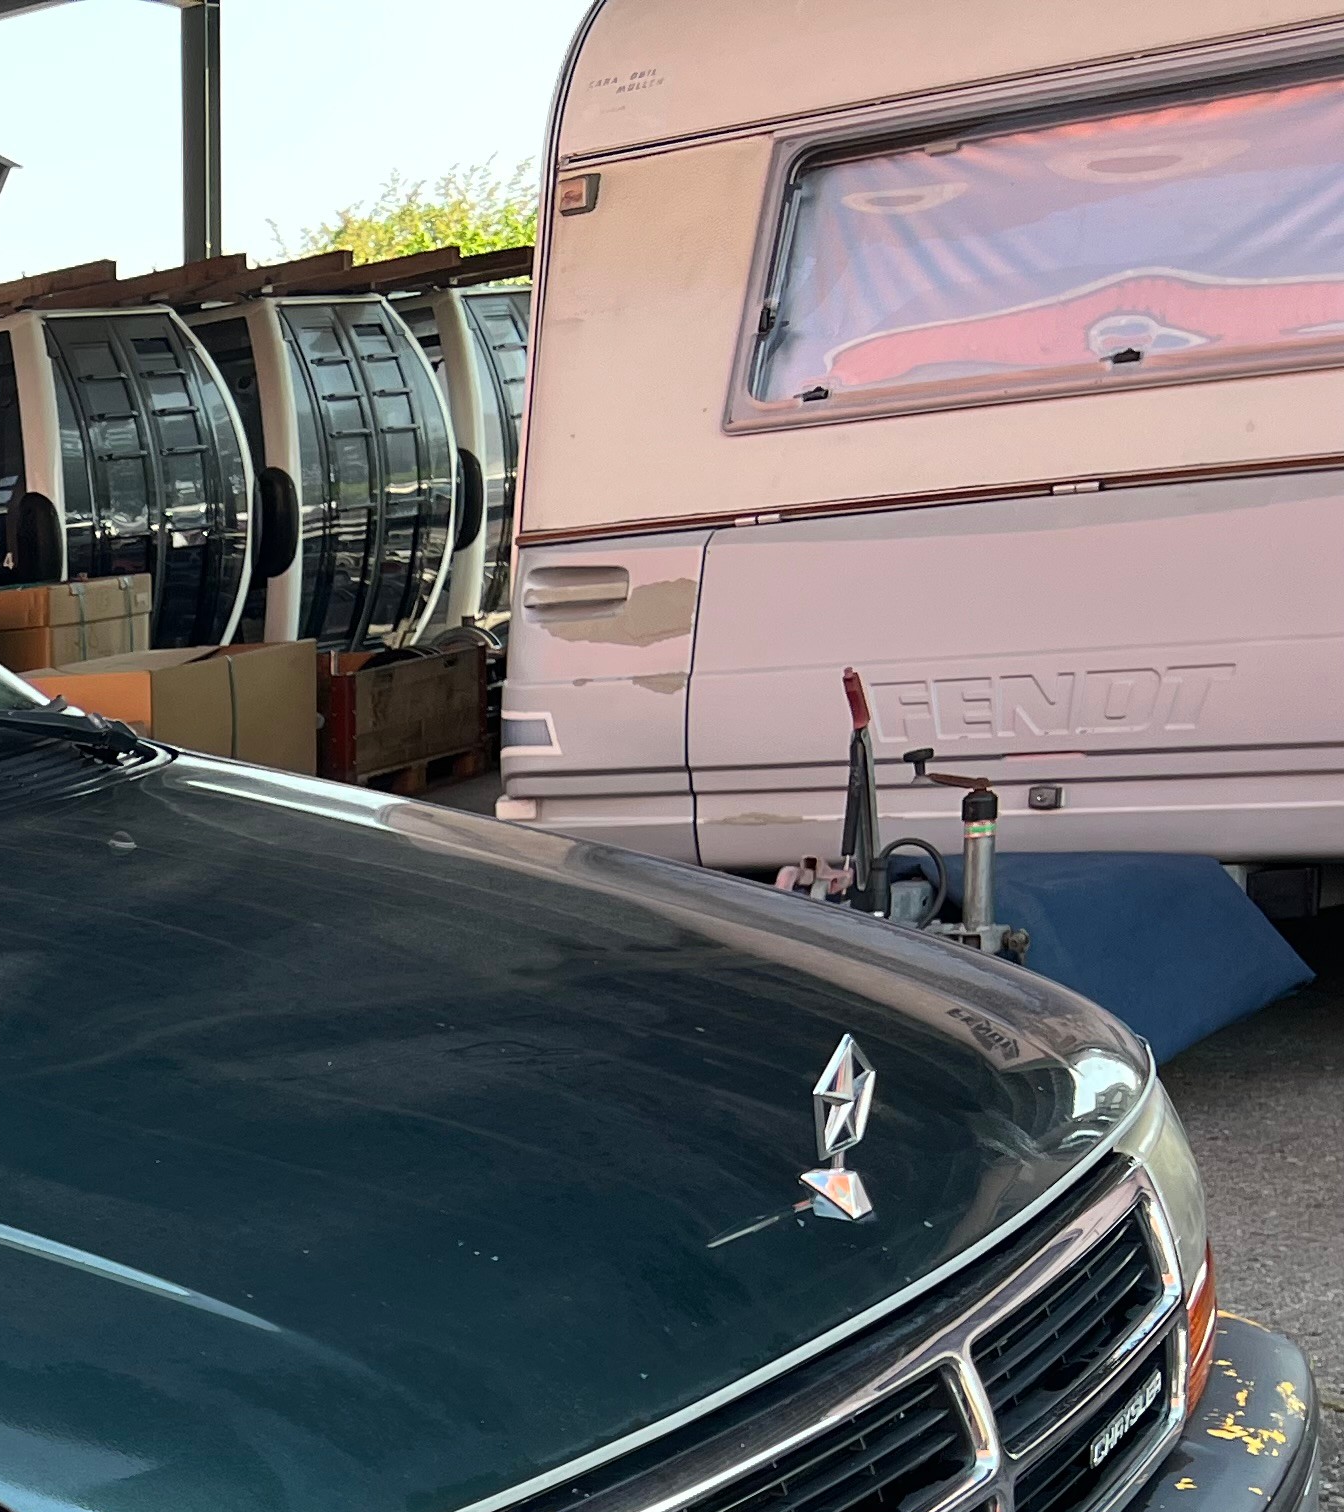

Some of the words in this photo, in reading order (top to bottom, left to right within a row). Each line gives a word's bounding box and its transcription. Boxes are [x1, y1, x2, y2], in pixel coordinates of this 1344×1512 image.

[3, 552, 14, 570] 4
[869, 663, 1237, 743] FENDT
[1094, 1371, 1162, 1467] CHRYSLER
